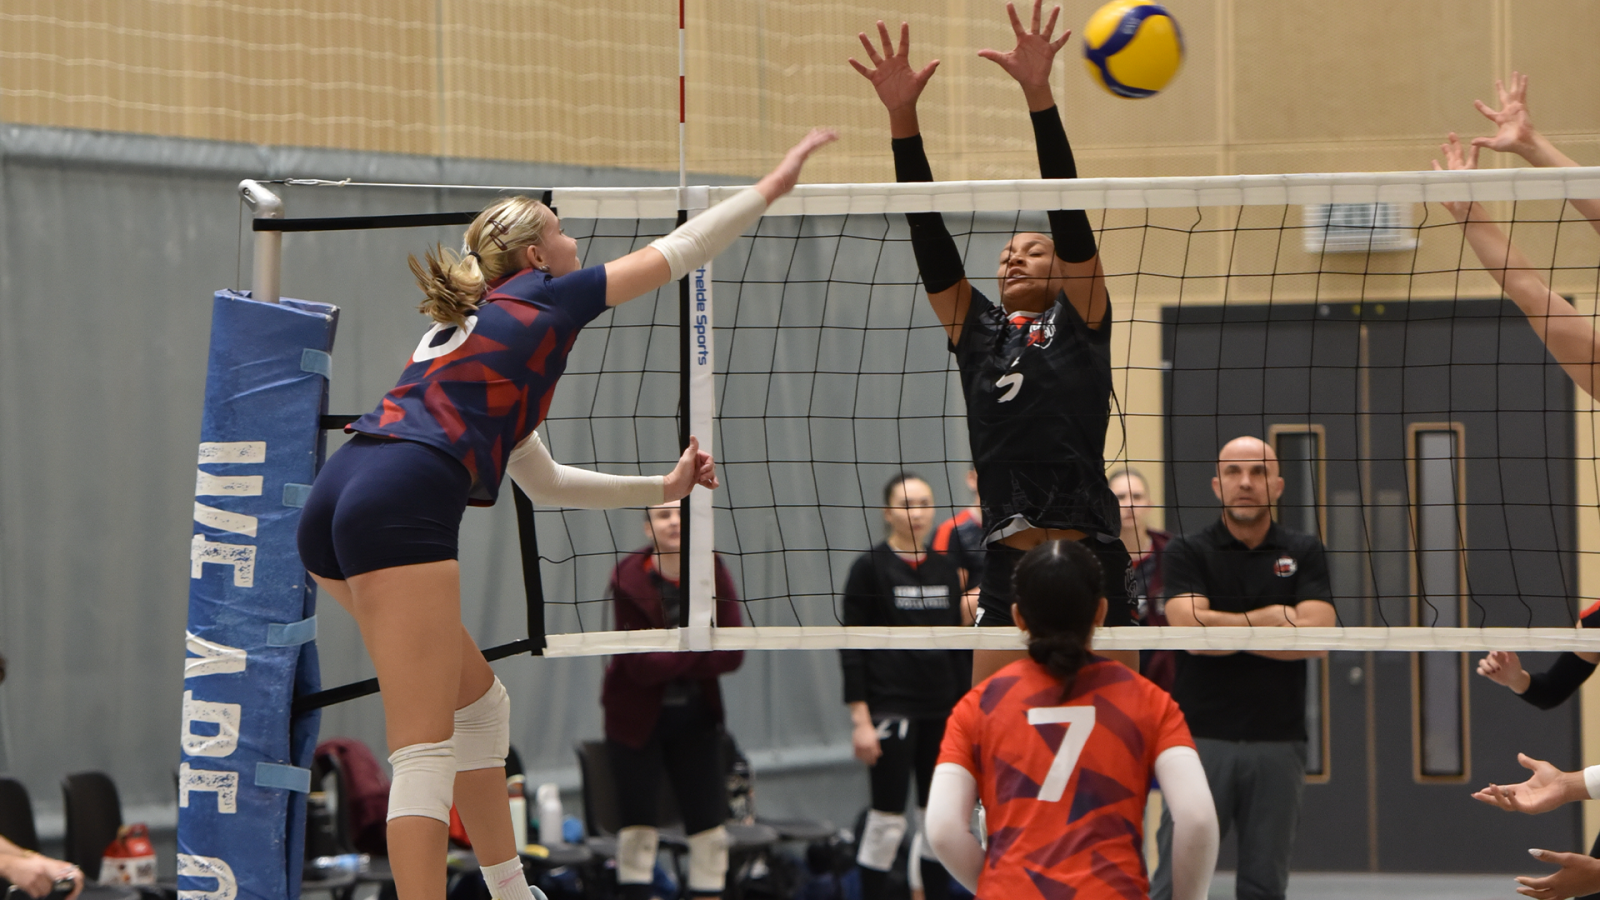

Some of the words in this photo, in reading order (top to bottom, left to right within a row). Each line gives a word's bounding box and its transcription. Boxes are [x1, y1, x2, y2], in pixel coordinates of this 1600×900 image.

[695, 264, 707, 312] helde
[694, 314, 709, 366] Sports
[1027, 705, 1096, 802] 7
